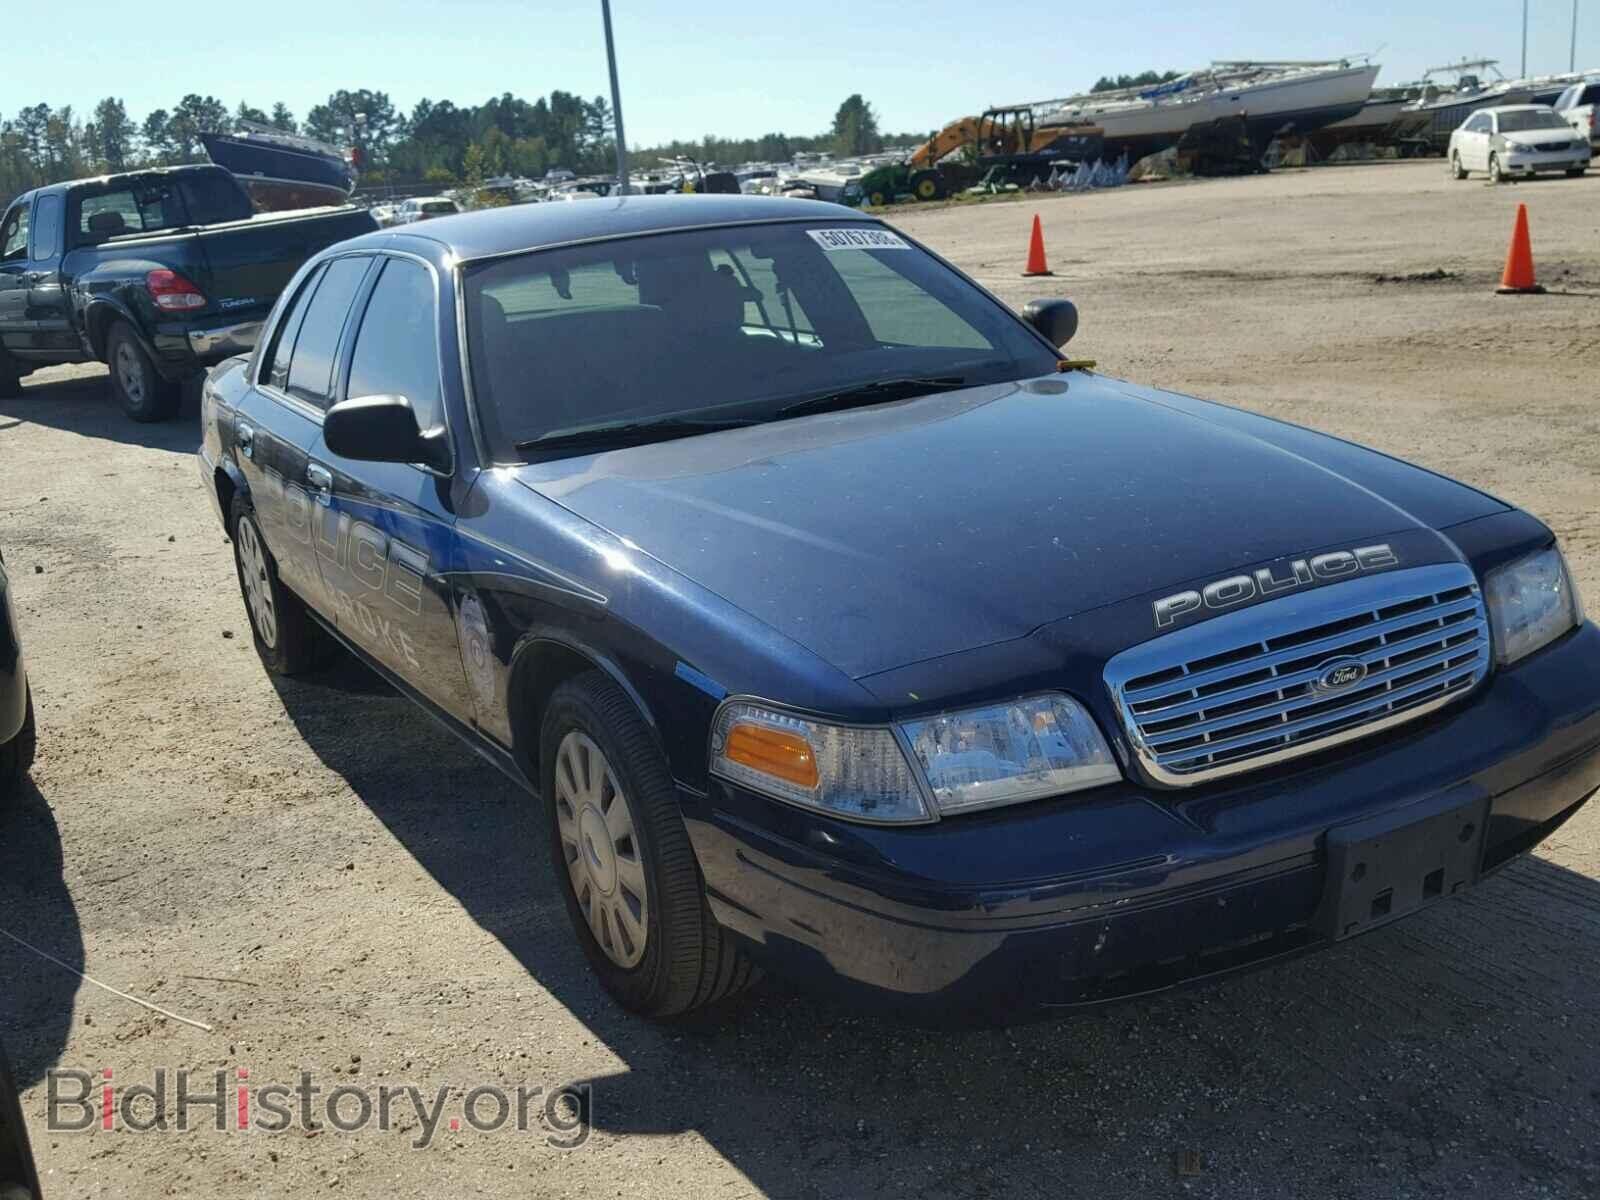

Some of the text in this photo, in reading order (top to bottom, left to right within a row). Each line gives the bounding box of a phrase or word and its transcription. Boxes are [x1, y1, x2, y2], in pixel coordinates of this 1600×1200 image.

[261, 463, 430, 617] POLICE
[1152, 543, 1399, 628] POLICE
[1332, 666, 1358, 684] Ford
